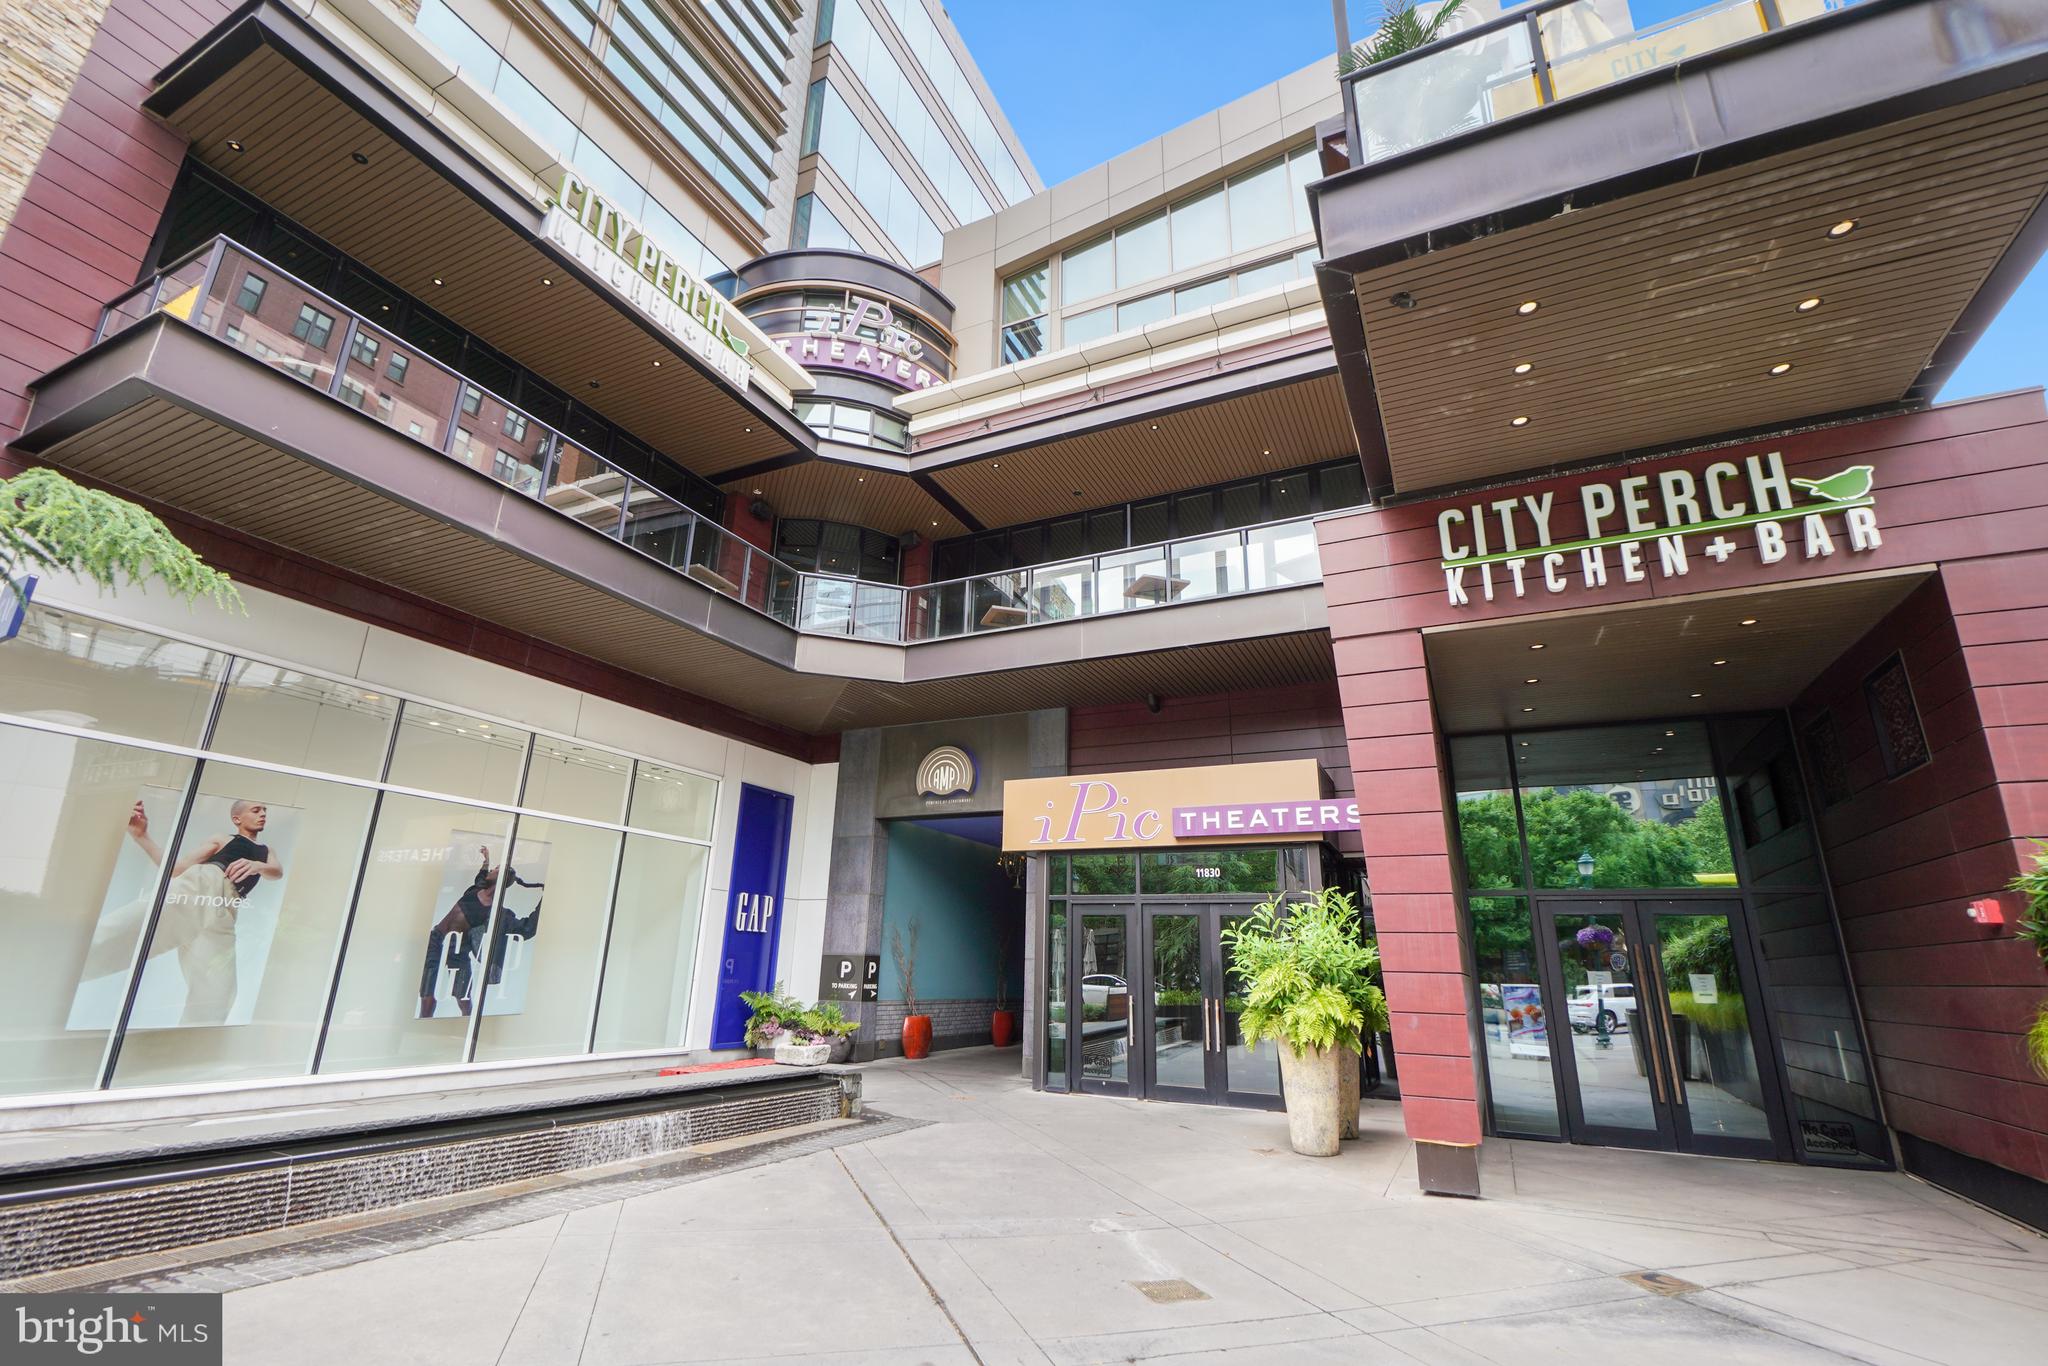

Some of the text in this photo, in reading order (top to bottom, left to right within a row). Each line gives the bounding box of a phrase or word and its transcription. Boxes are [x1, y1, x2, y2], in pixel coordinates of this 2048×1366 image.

[558, 172, 726, 337] CITY PERCH
[552, 211, 681, 334] KITCHEN
[702, 331, 748, 387] BAR
[811, 295, 925, 362] iPic
[774, 338, 944, 390] THEATER
[1437, 452, 1794, 562] CITY PERCH
[1445, 535, 1689, 606] KITCHEN
[1755, 507, 1883, 565] BAR
[933, 765, 956, 791] AMP
[1029, 780, 1361, 844] iPic THEATERS
[1196, 868, 1221, 878] 11830
[736, 892, 773, 933] GAP
[840, 961, 852, 978] P
[868, 961, 877, 979] P
